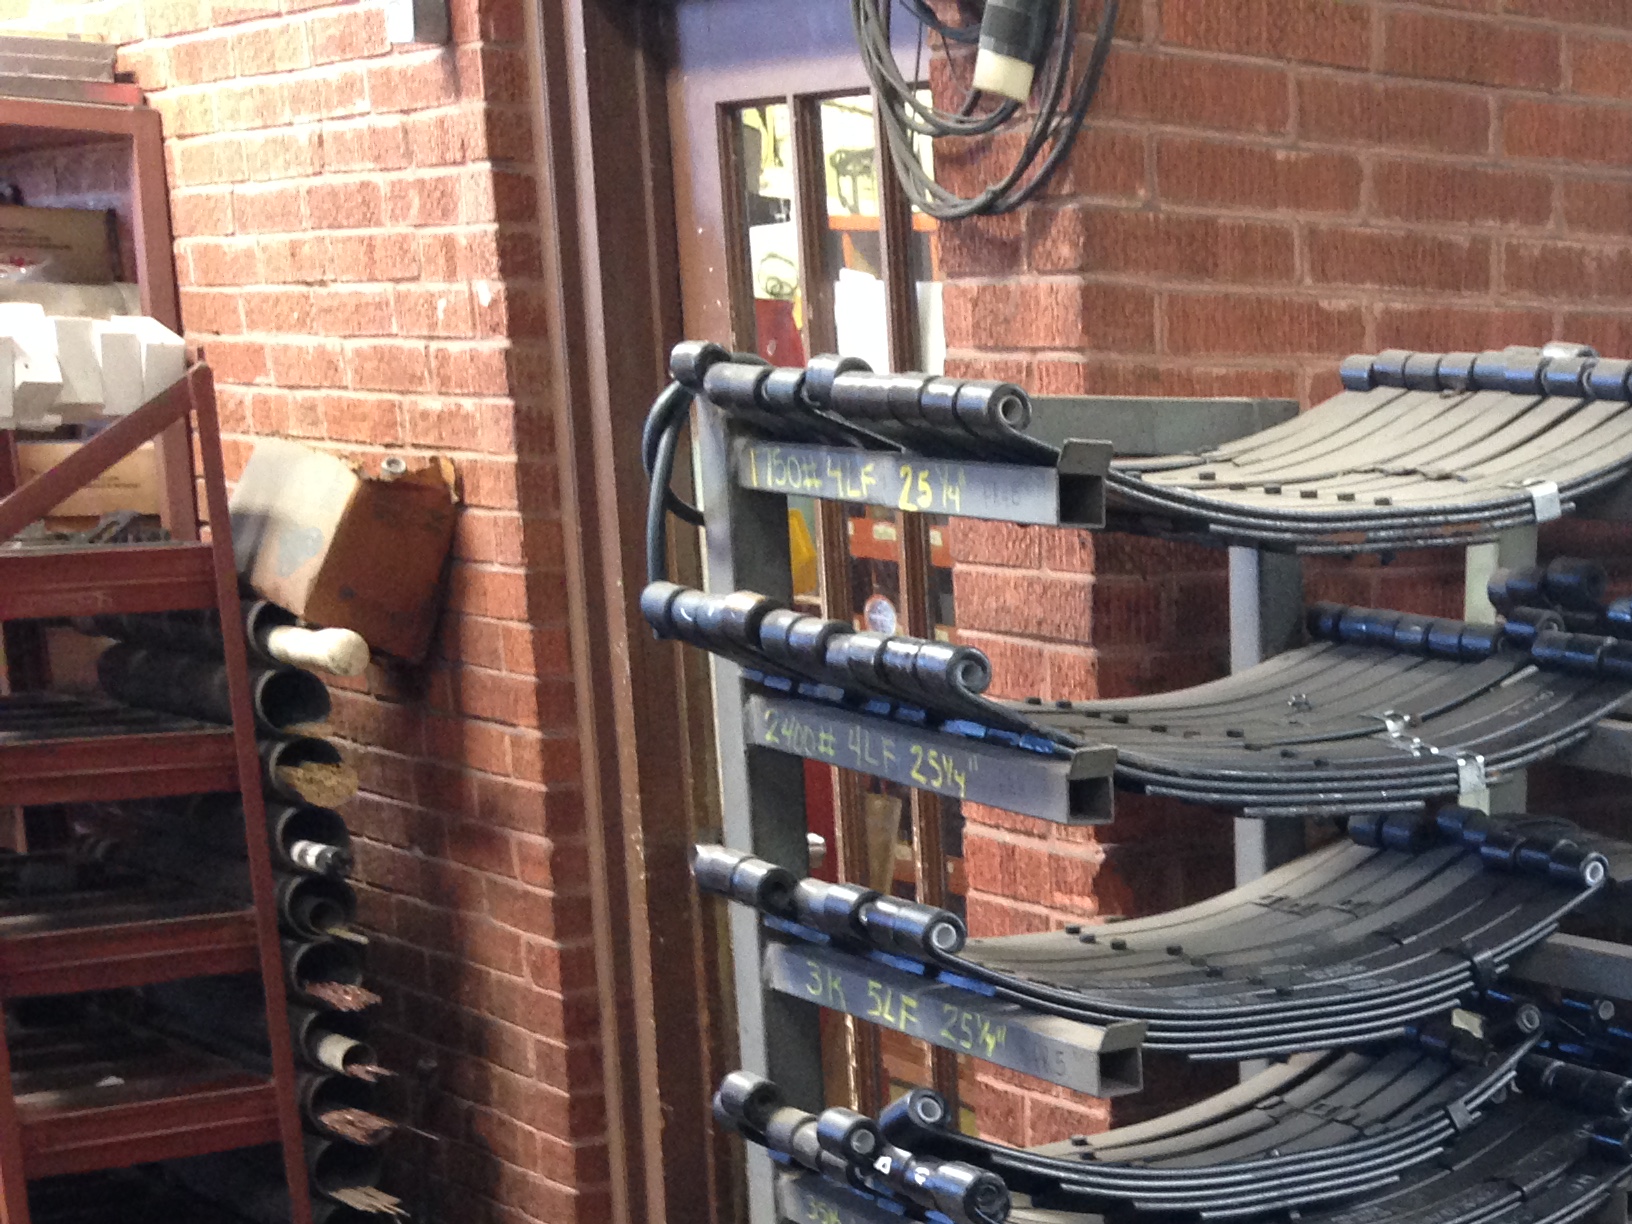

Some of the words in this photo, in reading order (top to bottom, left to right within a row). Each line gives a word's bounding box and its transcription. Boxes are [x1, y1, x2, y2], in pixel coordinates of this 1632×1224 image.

[899, 464, 933, 511] 25
[847, 725, 896, 773] 4LF
[867, 979, 919, 1031] 5LF
